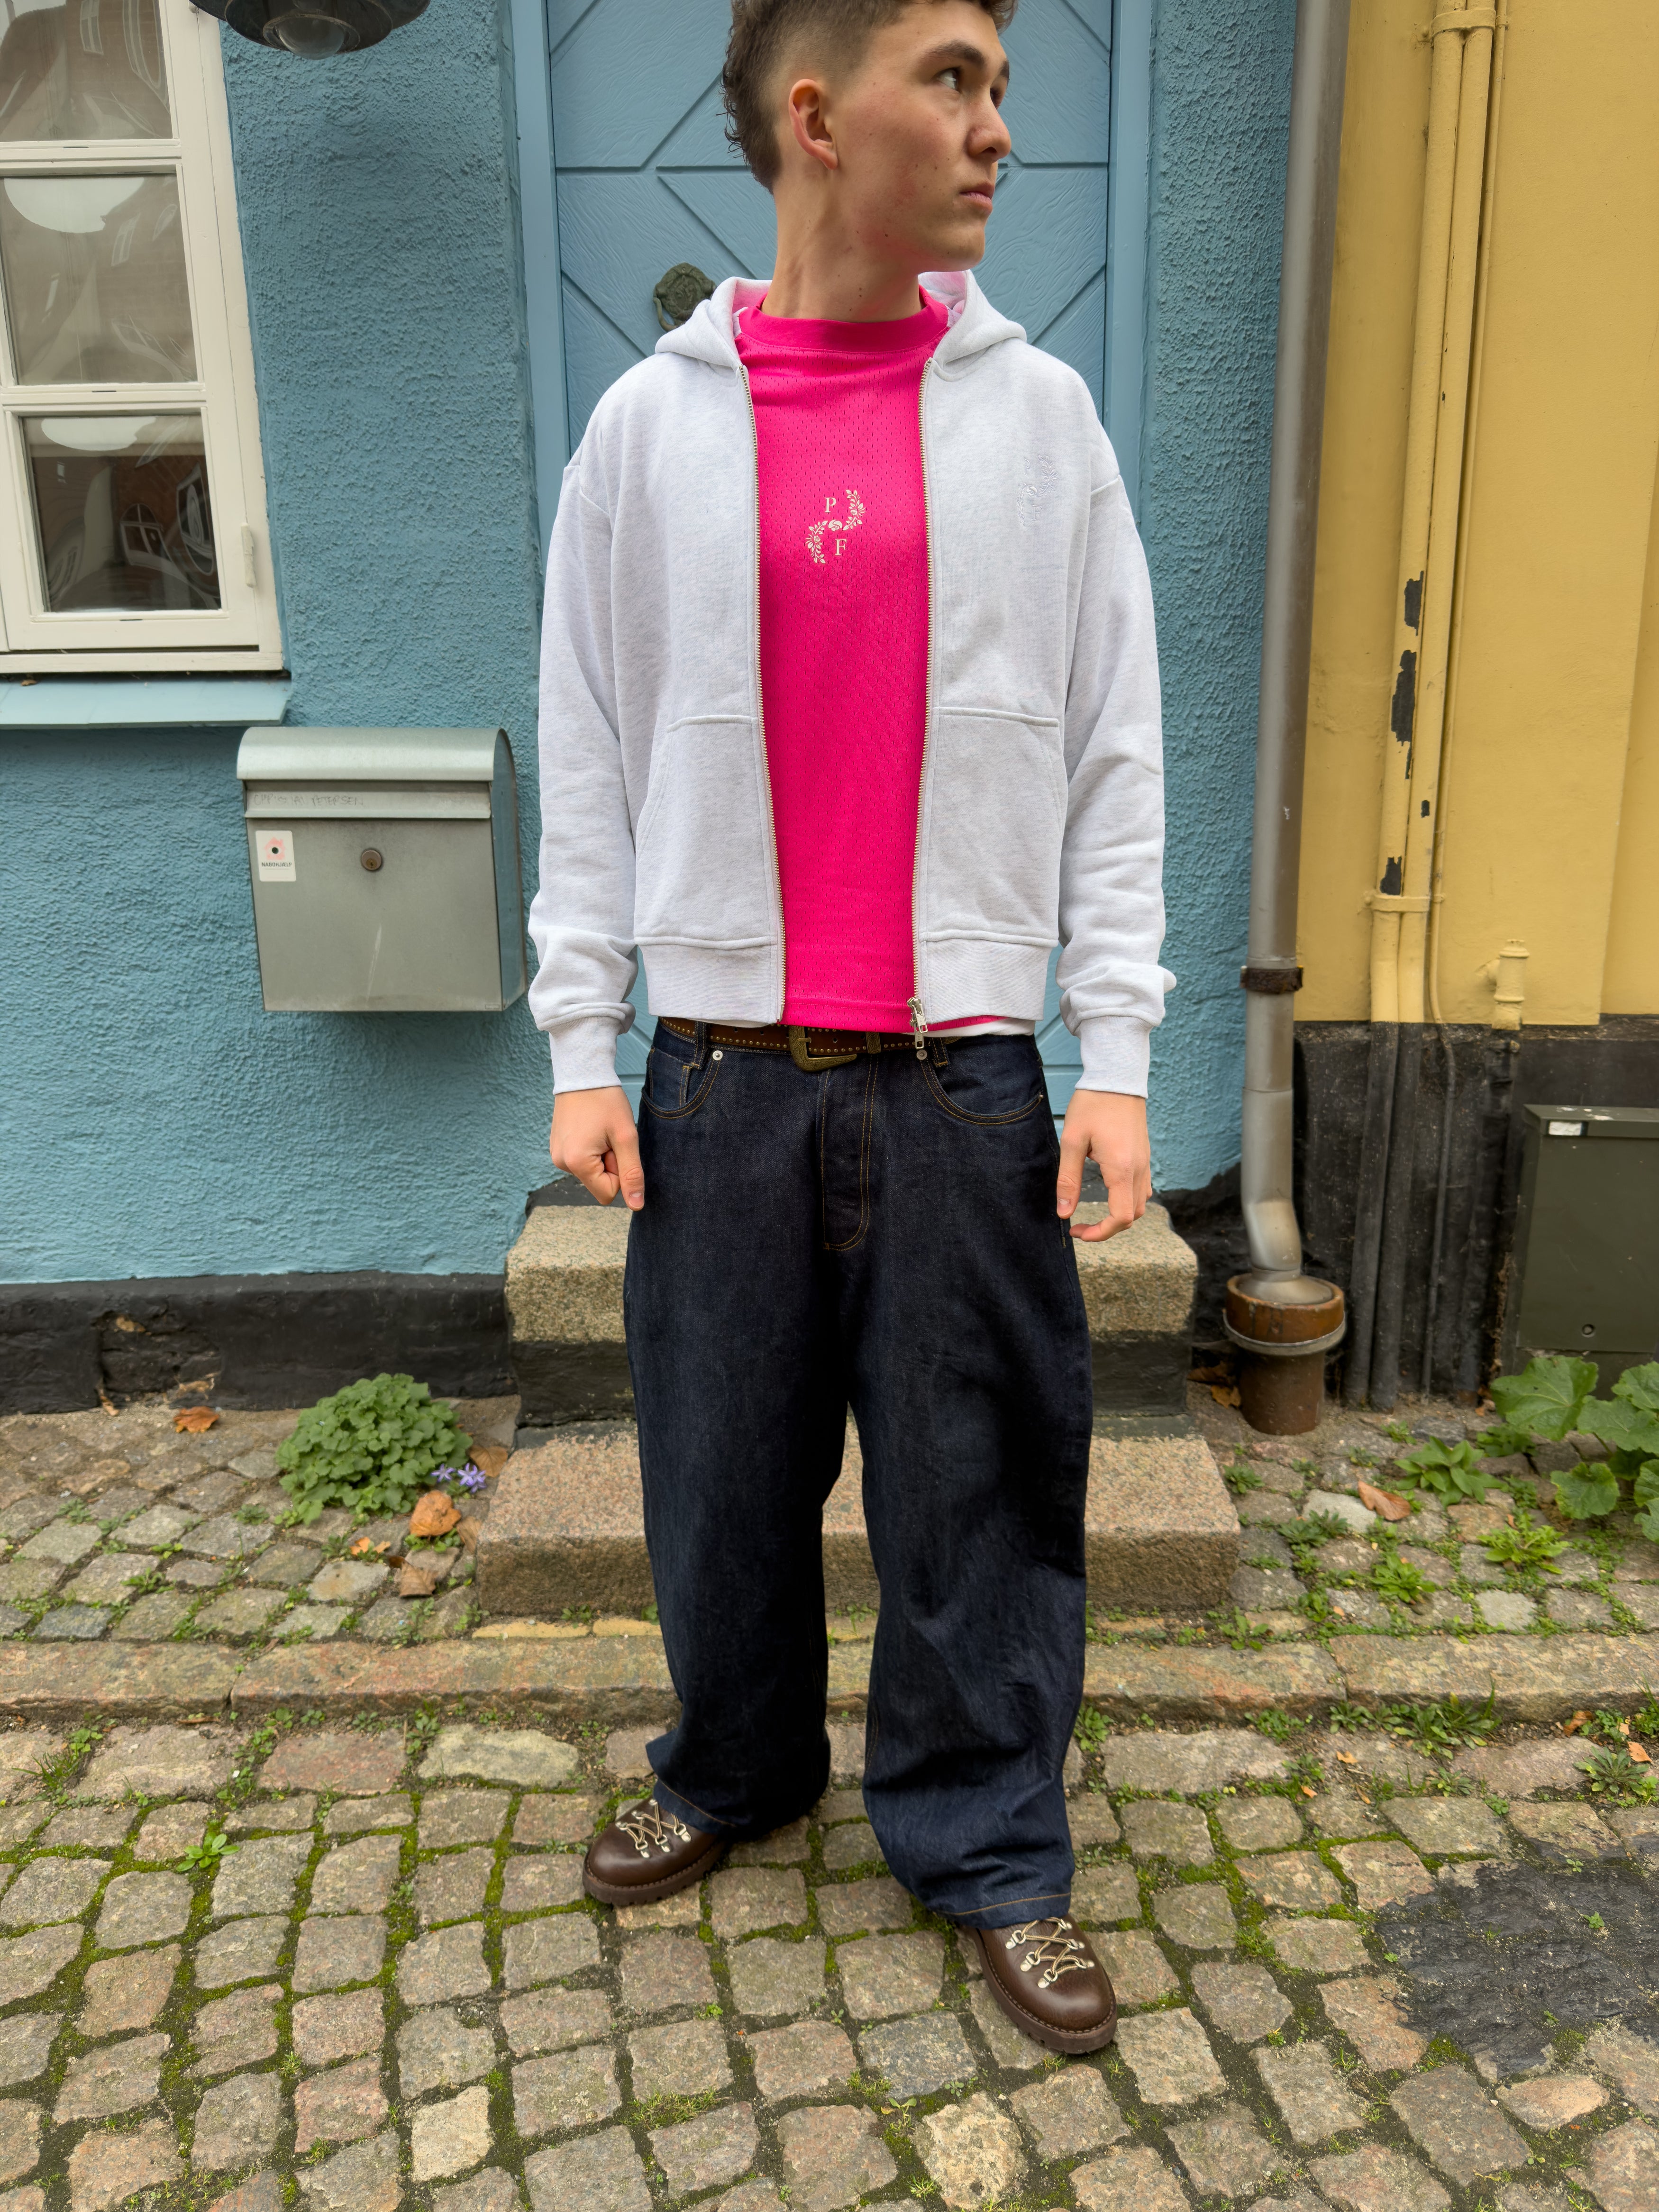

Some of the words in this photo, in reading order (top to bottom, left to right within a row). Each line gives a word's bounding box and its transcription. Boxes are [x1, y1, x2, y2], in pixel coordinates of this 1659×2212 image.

[825, 497, 837, 513] P
[1031, 504, 1043, 521] F
[835, 538, 847, 555] F
